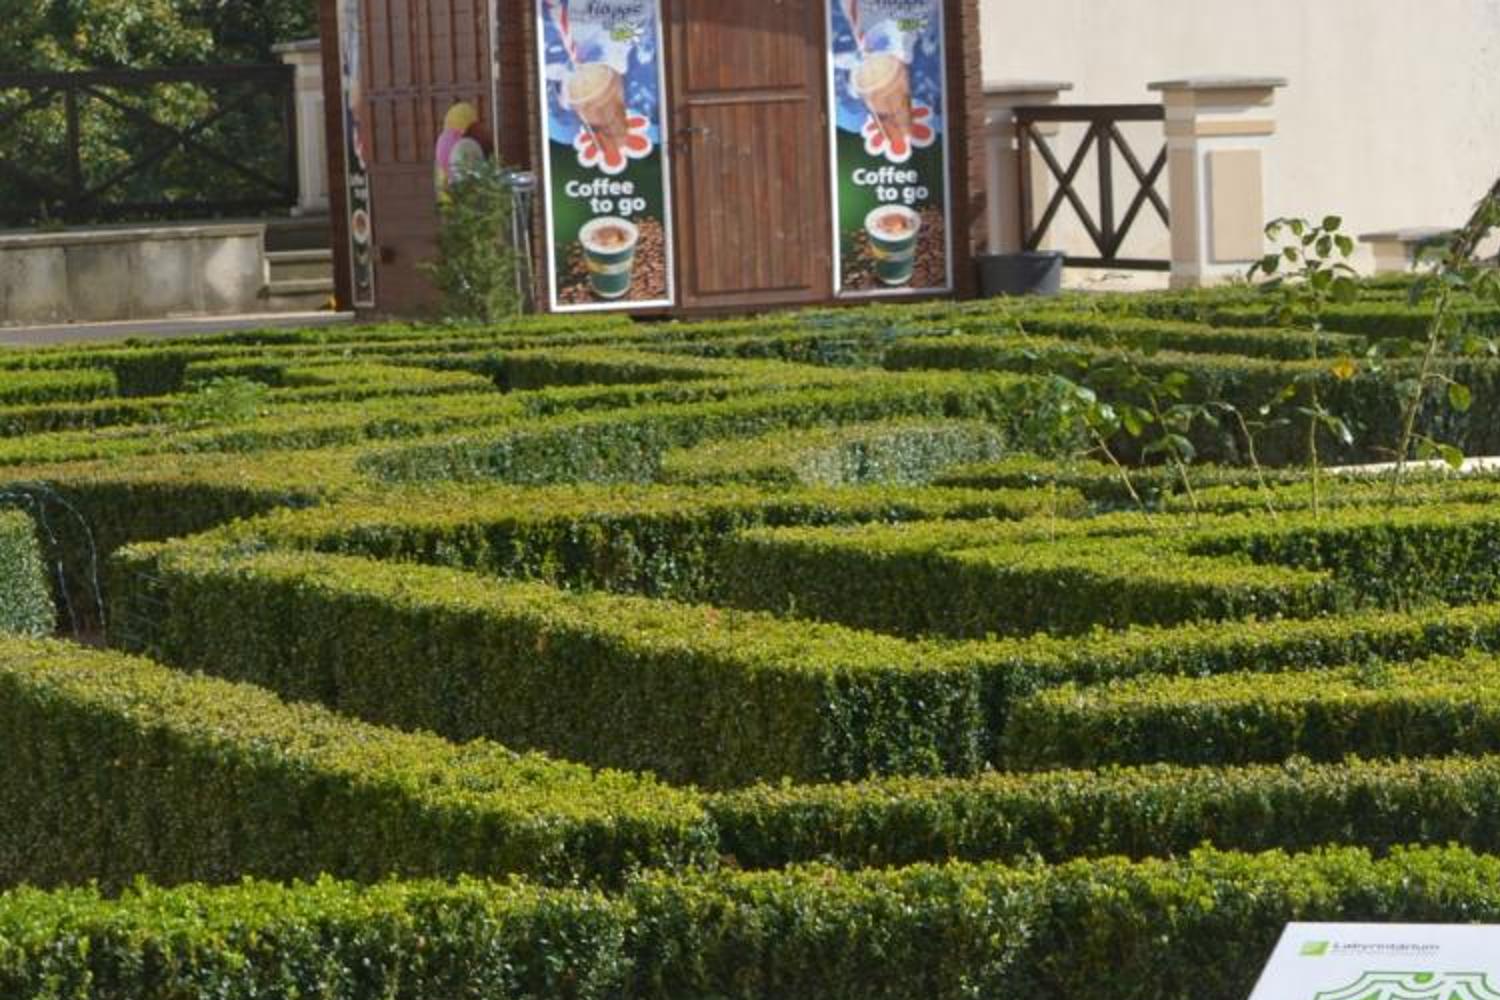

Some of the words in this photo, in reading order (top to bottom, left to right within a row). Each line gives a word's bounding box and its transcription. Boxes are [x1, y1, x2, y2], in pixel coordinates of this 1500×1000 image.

[852, 166, 918, 185] Coffee
[565, 178, 635, 197] Coffee
[876, 185, 899, 202] to
[902, 186, 929, 205] go
[590, 198, 614, 213] to
[618, 197, 647, 216] go
